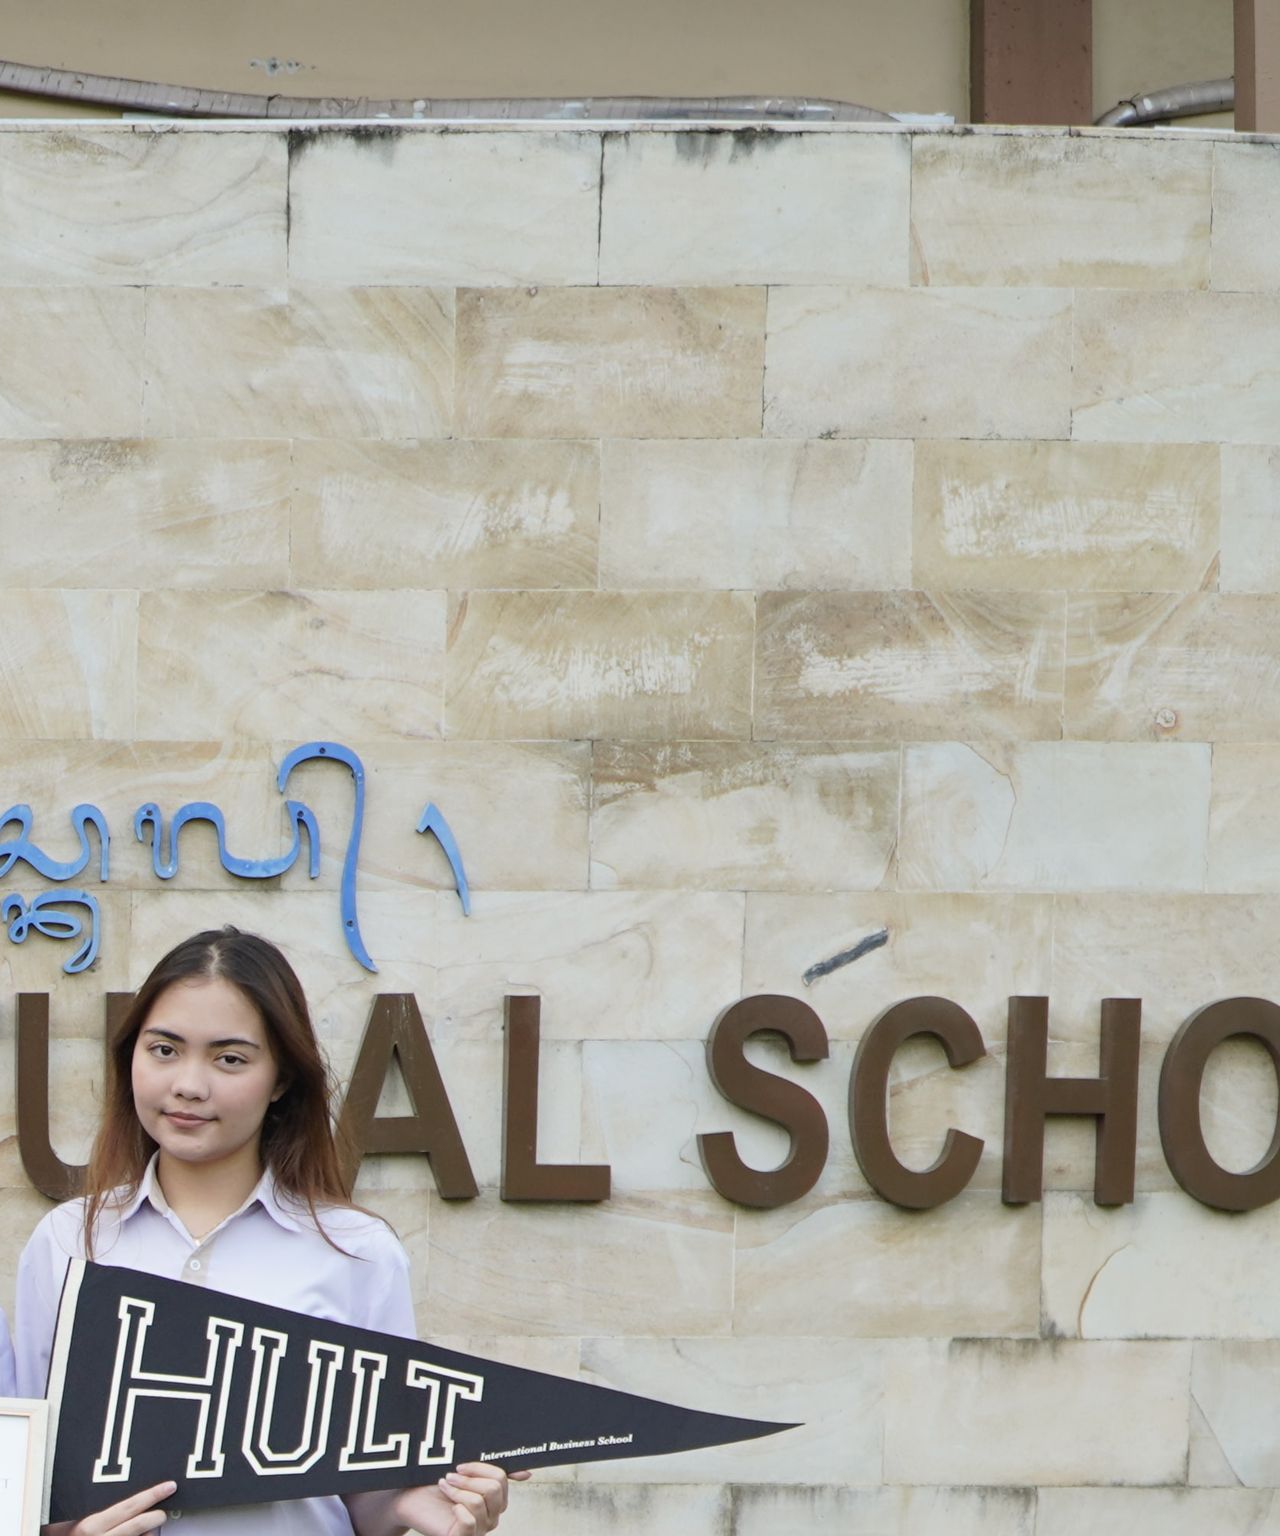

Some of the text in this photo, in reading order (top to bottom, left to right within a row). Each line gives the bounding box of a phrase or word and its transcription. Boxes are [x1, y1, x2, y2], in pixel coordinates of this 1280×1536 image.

[92, 1296, 484, 1482] HULT
[480, 1434, 633, 1461] International Business School
